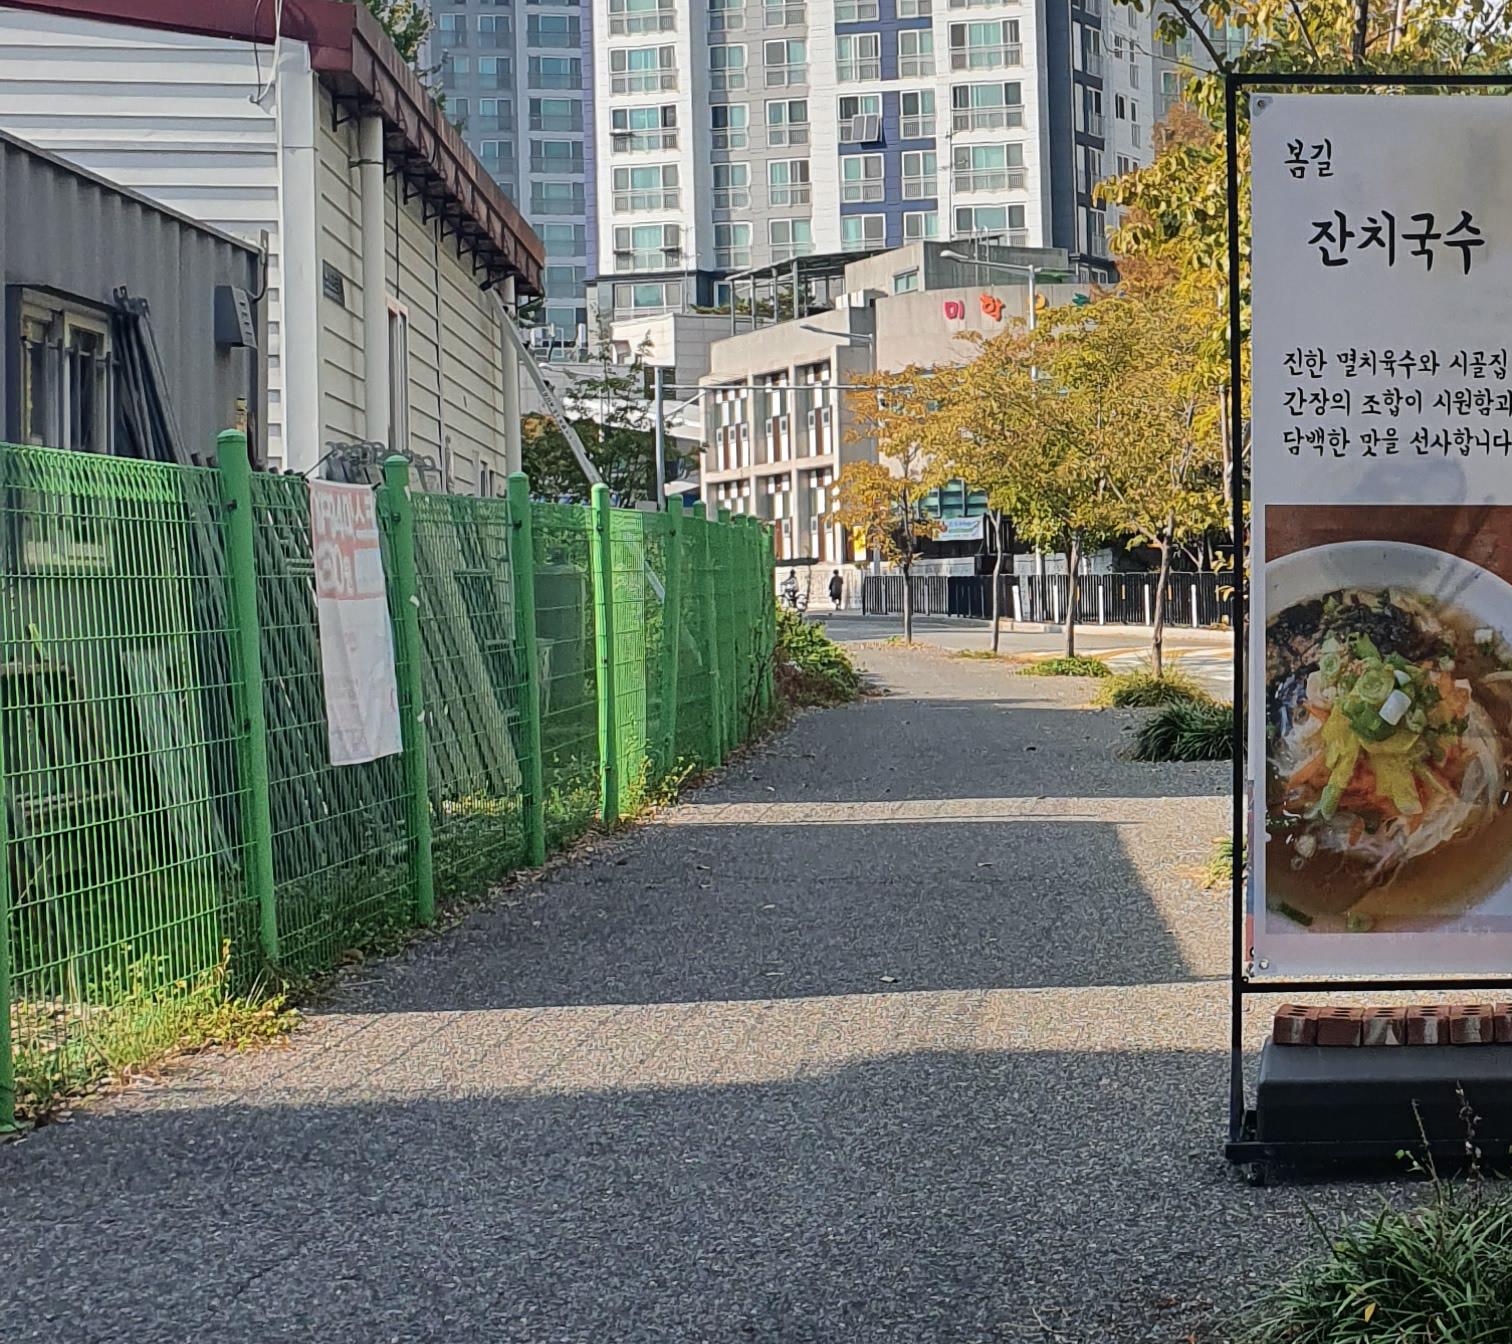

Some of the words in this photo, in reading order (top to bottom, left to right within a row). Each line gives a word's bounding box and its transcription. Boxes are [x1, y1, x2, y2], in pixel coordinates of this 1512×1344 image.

[1284, 138, 1334, 179] 봄길
[1307, 209, 1486, 275] 잔치국수
[1283, 347, 1328, 379] 진한
[1336, 347, 1441, 380] 멸치육수와
[1449, 348, 1508, 380] 시골집
[1283, 386, 1351, 417] 간장의
[1361, 387, 1423, 418] 조합이
[1283, 426, 1351, 458] 담백한
[1360, 426, 1400, 458] 맛을
[1409, 426, 1512, 457] 선사합니다
